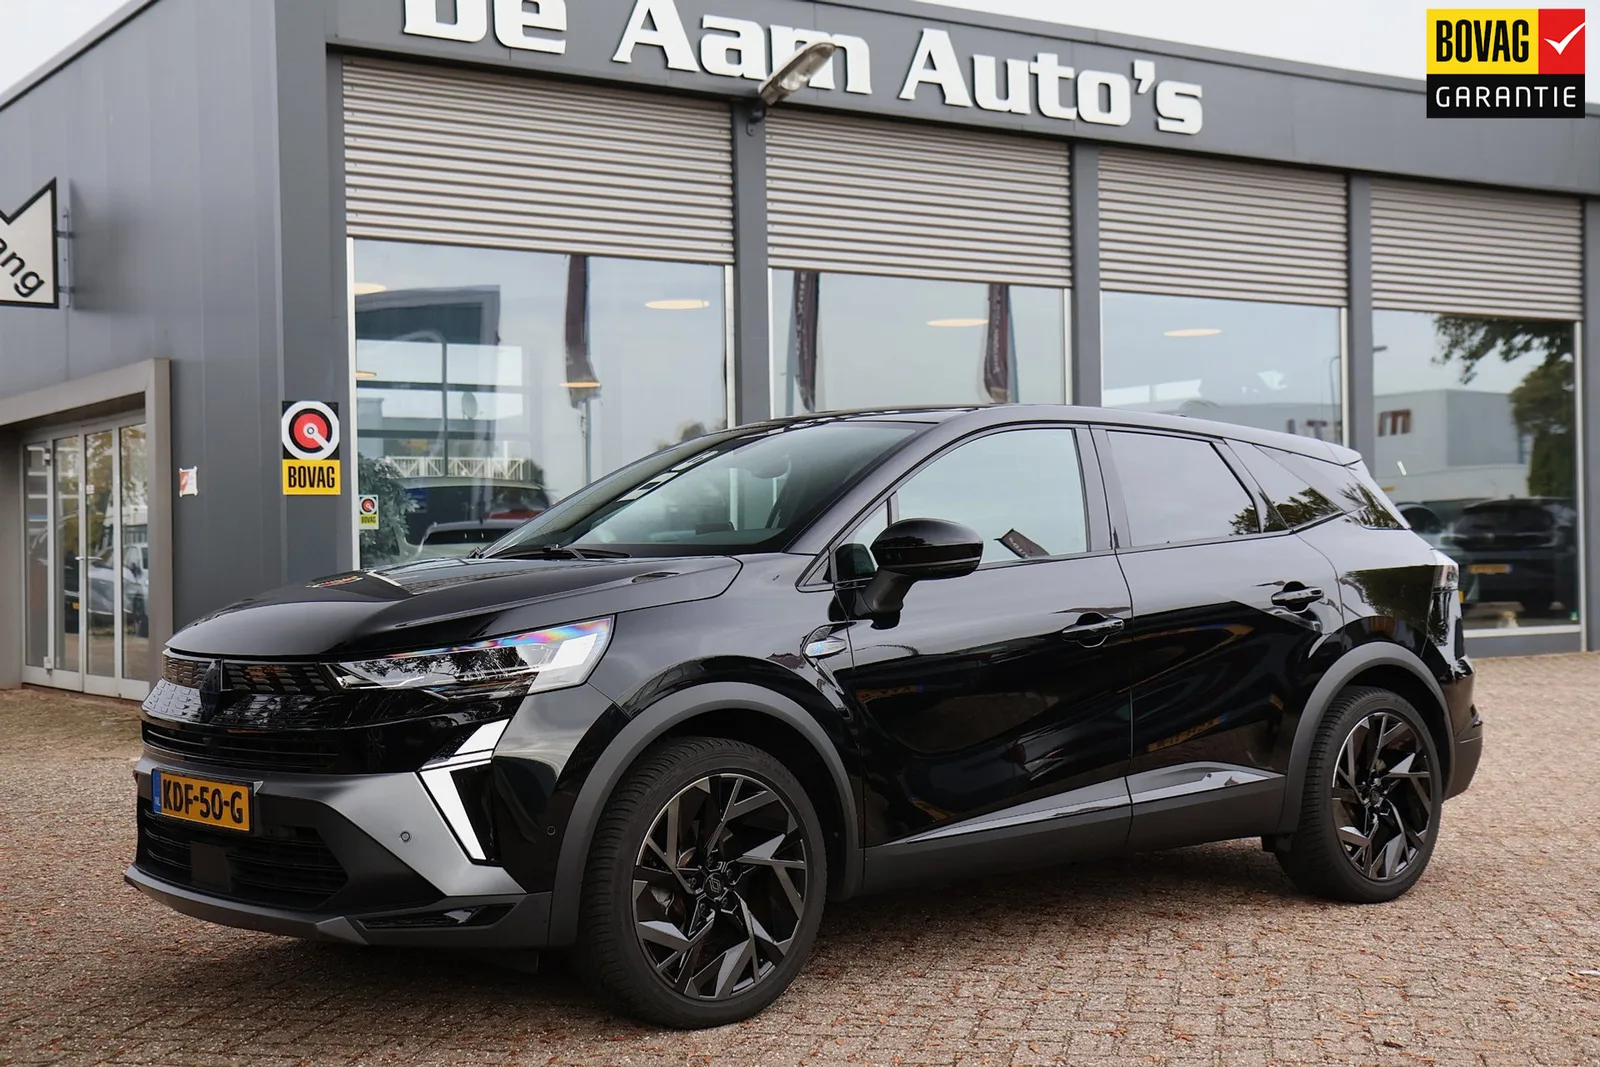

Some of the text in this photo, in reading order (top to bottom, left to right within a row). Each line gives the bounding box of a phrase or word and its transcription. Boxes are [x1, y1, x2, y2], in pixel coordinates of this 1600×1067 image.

[611, 0, 872, 94] Aam
[898, 27, 1203, 135] Auto's
[287, 465, 336, 489] BOVAG
[162, 778, 245, 825] KDF-50-G
